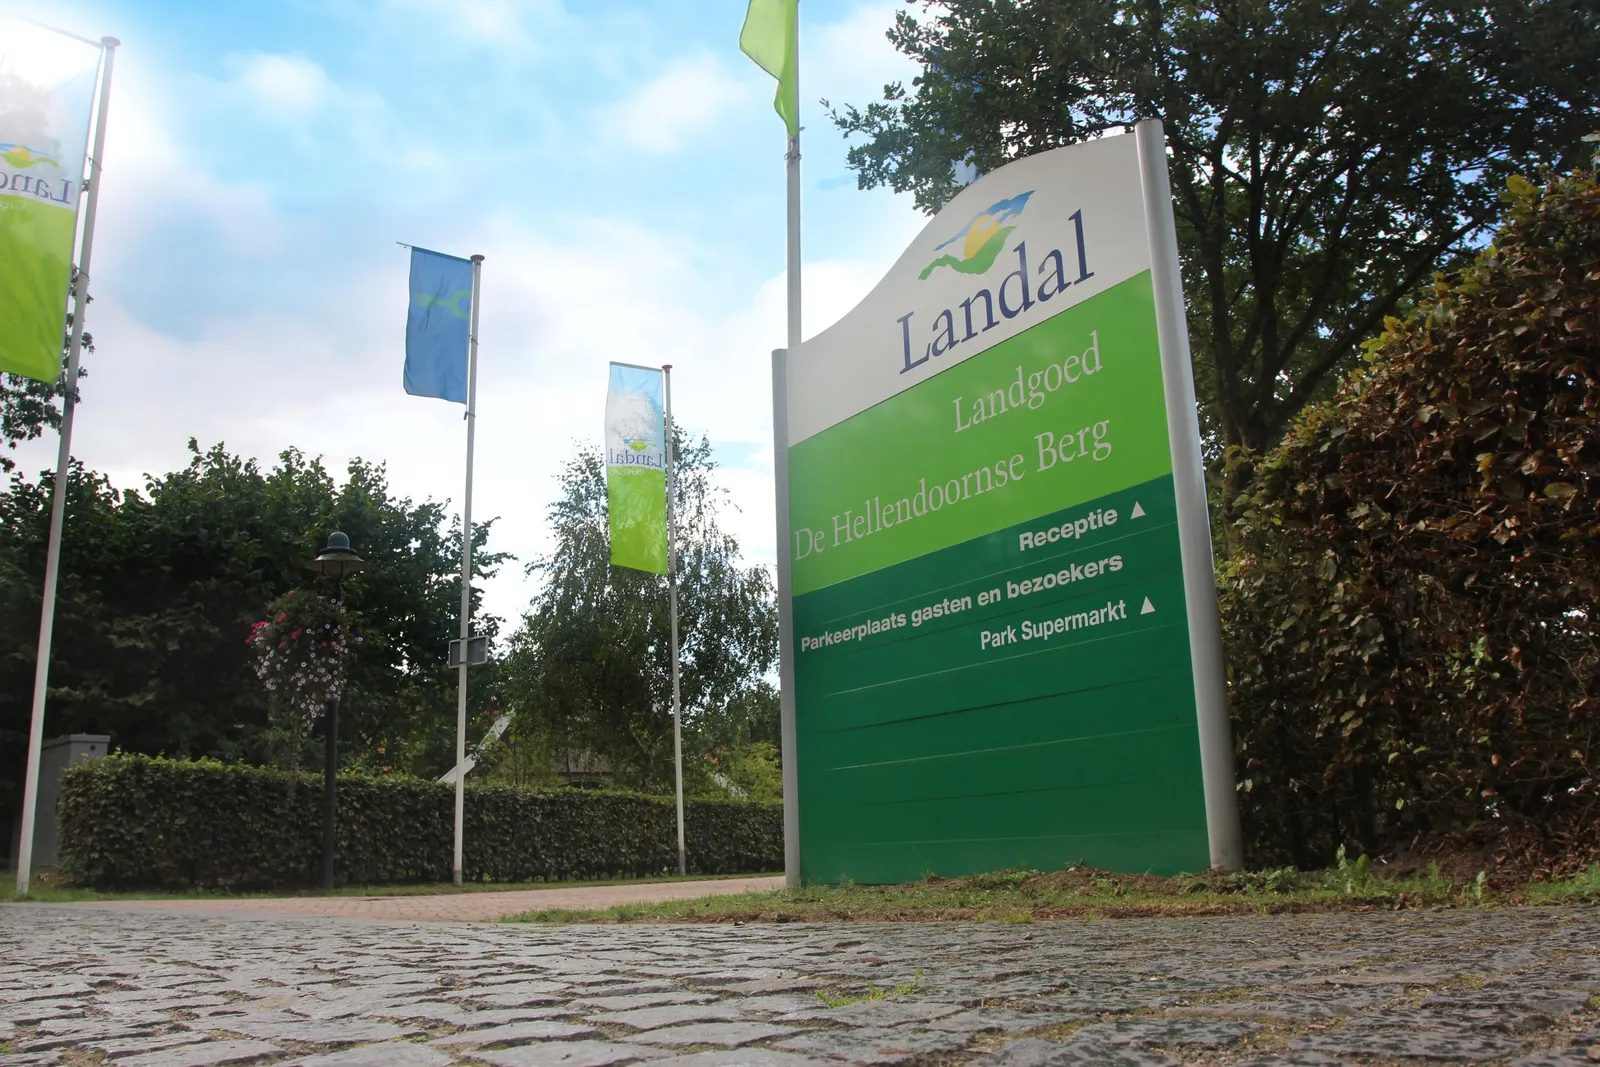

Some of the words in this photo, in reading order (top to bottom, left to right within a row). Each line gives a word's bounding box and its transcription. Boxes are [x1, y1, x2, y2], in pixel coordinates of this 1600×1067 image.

[897, 208, 1095, 375] Landal
[952, 330, 1103, 434] Landgoed
[793, 527, 826, 561] De
[831, 453, 1025, 548] Hellendoornse
[1033, 419, 1113, 473] Berg
[1018, 507, 1119, 552] Receptie
[800, 610, 907, 653] Parkeerplaats
[911, 594, 972, 627] gasten
[977, 588, 1001, 607] en
[1006, 553, 1124, 600] bezoekers
[980, 624, 1018, 650] Park
[1021, 598, 1127, 642] Supermarkt
